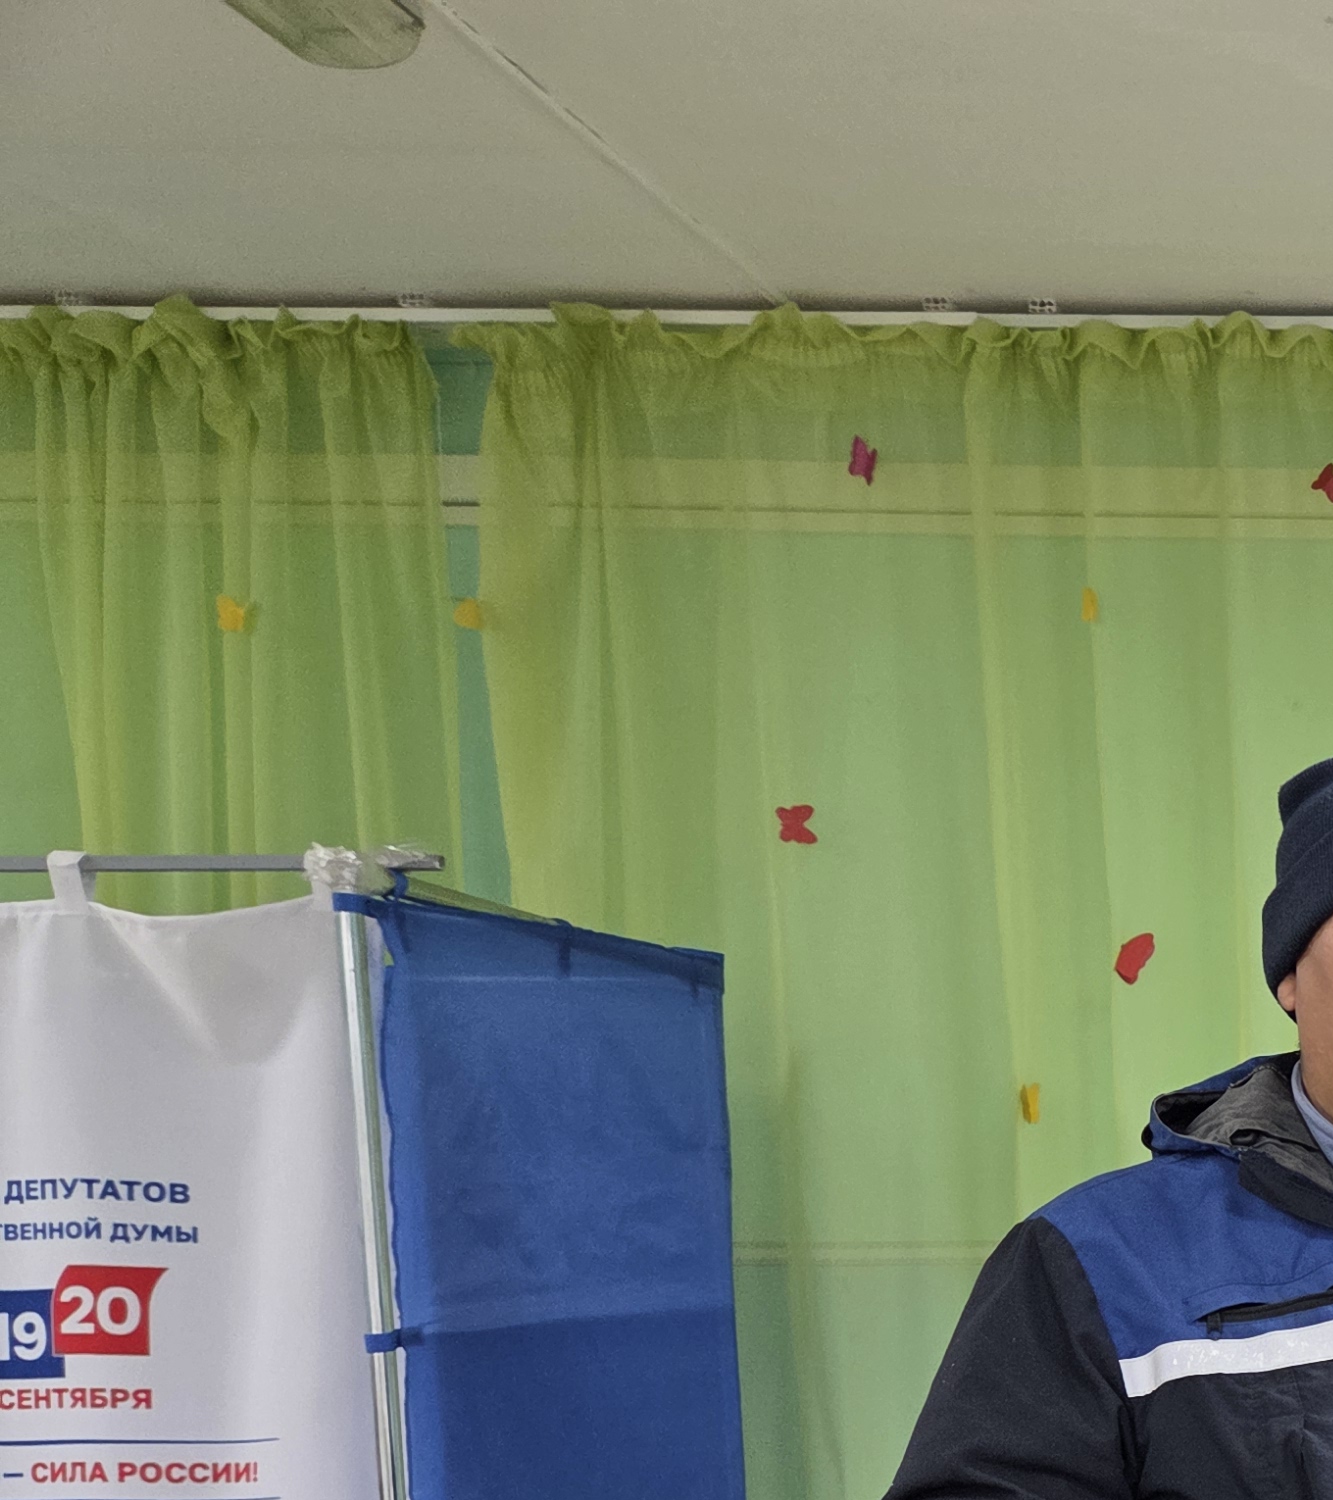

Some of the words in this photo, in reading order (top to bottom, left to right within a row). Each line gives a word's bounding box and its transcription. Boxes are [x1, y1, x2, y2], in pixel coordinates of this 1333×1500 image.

[4, 1178, 191, 1204] ДЕПУТАТОВ
[110, 1223, 199, 1244] ДУМЫ
[60, 1284, 141, 1336] 20
[0, 1388, 153, 1410] СЕНТЯБРЯ
[31, 1463, 109, 1483] СИЛА
[117, 1462, 259, 1484] РОССИИ!
